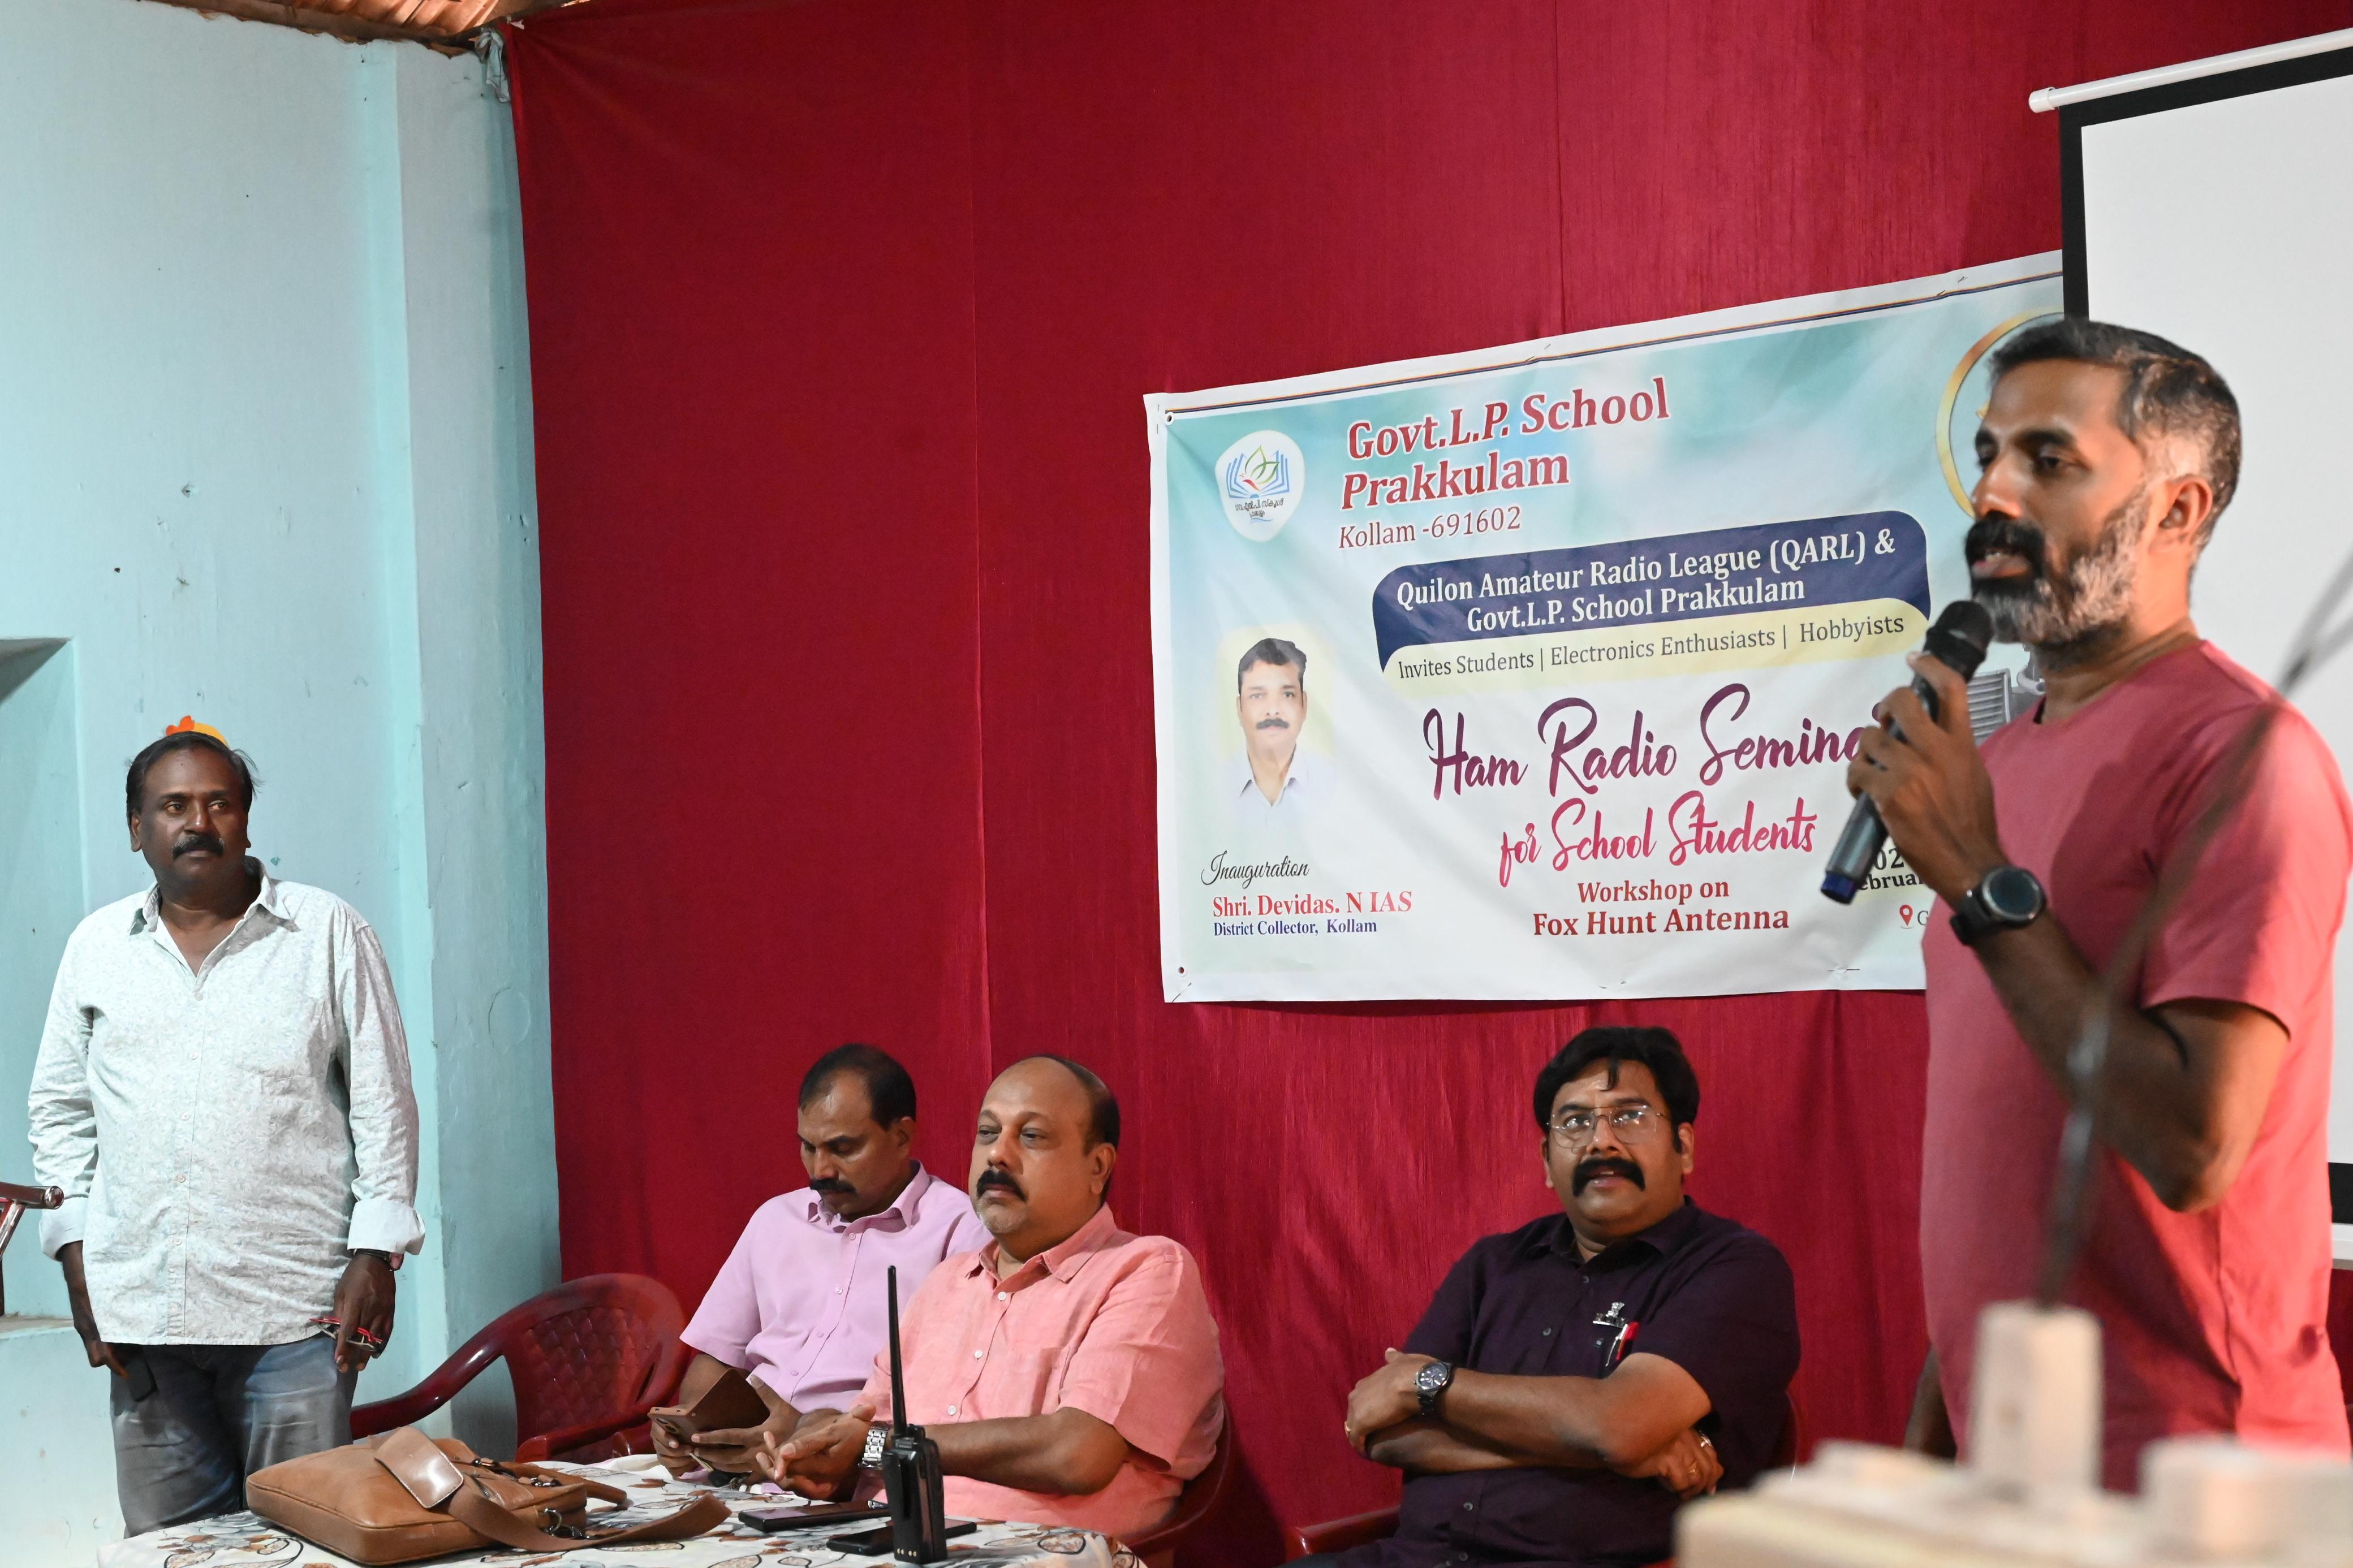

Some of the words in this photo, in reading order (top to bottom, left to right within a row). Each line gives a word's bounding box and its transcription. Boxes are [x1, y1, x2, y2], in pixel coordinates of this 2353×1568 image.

[1348, 401, 1509, 459] Govt.L.P.
[1522, 377, 1670, 433] School
[1341, 452, 1569, 510] Prakkulam
[1338, 521, 1415, 549] Kollam
[1422, 506, 1522, 538] -691602
[1397, 577, 1473, 611] Quilon
[1479, 568, 1584, 598] Amateur
[1589, 555, 1663, 586] Radio
[1669, 548, 1761, 580] League
[1769, 530, 1867, 574] (QARL)
[1874, 528, 1896, 555] &
[1468, 599, 1565, 632] Govt.L.P.
[1571, 590, 1653, 623] School
[1661, 577, 1805, 614] Prakkulam
[1398, 659, 1451, 679] Invites
[1456, 653, 1535, 674] Students
[1550, 640, 1654, 666] Electronics
[1661, 628, 1775, 656] Enthusiasts
[1800, 615, 1905, 642] Hobbyists
[1423, 708, 1528, 801] Ham
[1537, 697, 1677, 797] Radio
[1499, 822, 1542, 888] for
[1550, 797, 1656, 871] School
[1668, 790, 1817, 866] Students
[1201, 850, 1309, 888] Inauguration
[1578, 879, 1693, 905] Workshop
[1700, 881, 1730, 897] on
[1213, 896, 1252, 917] Shri.
[1257, 893, 1340, 915] Devidas.
[1346, 892, 1363, 913] N
[1371, 891, 1412, 913] IAS
[1213, 918, 1254, 937] District
[1257, 917, 1318, 936] Collector,
[1326, 918, 1377, 933] Kollam
[1533, 913, 1579, 936] Fox
[1585, 910, 1656, 935] Hunt
[1664, 908, 1790, 933] Antenna
